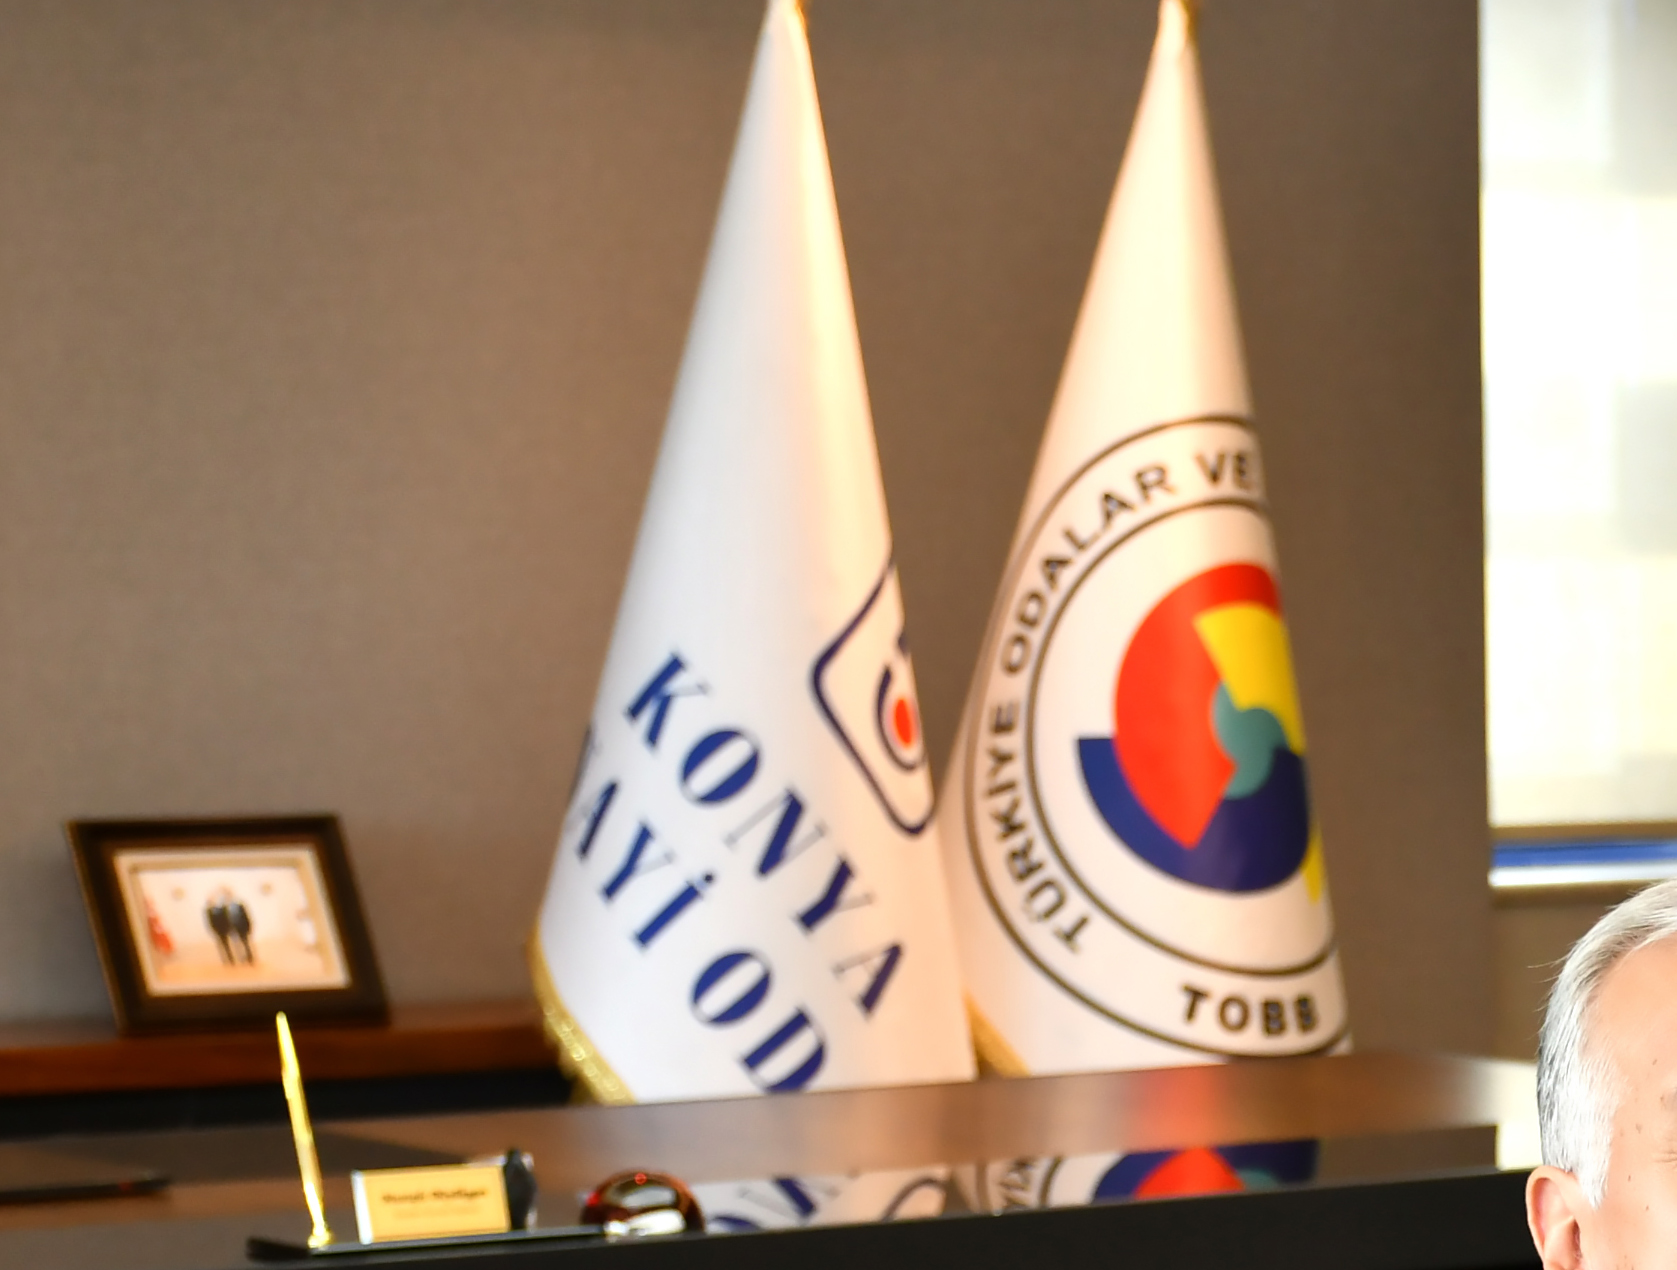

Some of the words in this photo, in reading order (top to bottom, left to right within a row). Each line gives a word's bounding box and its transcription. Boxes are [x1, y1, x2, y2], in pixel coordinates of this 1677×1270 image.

[1001, 464, 1178, 675] ODALAR
[565, 726, 717, 950] AYİ
[621, 648, 907, 1022] KONYA
[1180, 984, 1318, 1037] TOBB
